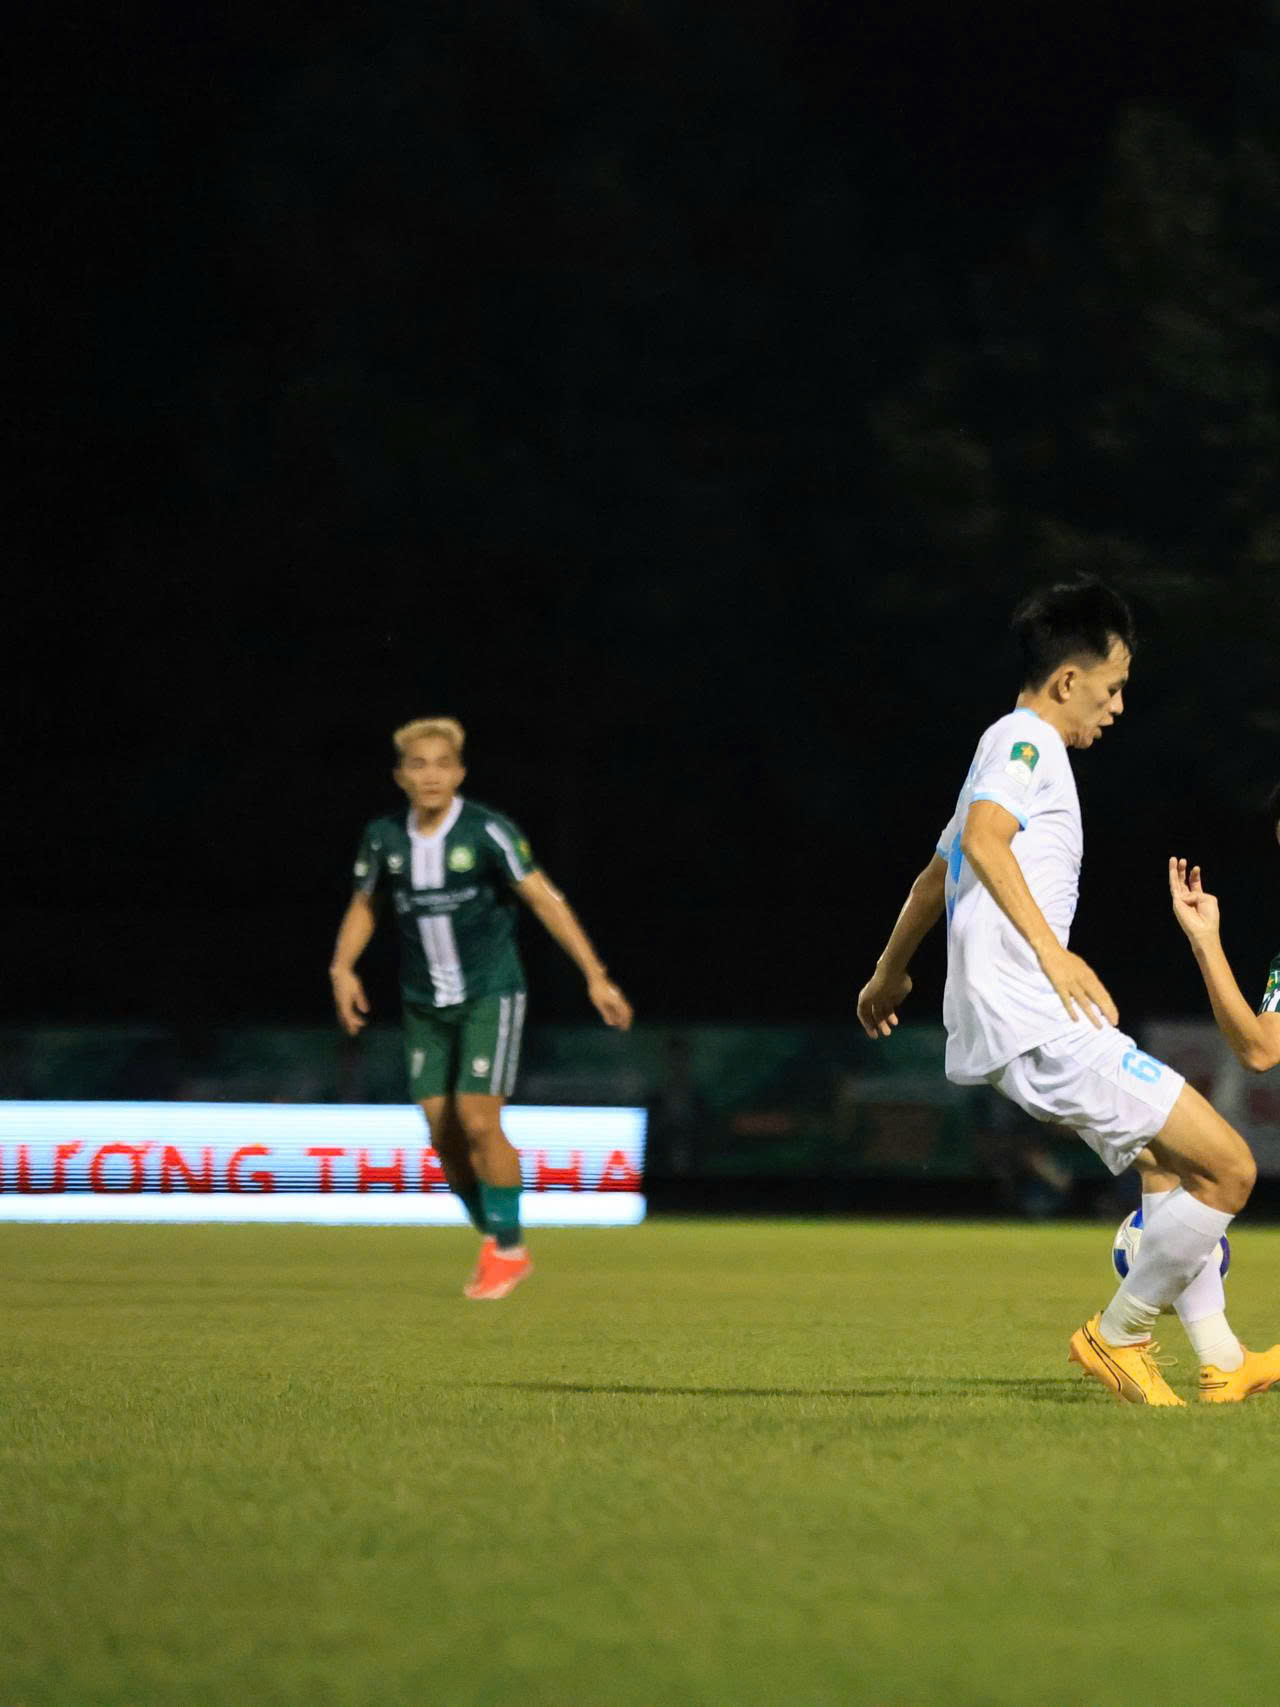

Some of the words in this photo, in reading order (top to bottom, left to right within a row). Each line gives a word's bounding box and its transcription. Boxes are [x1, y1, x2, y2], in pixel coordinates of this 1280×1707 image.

[1122, 1043, 1167, 1083] 6
[0, 1140, 273, 1194] ƯƠNG
[516, 1147, 641, 1193] HA
